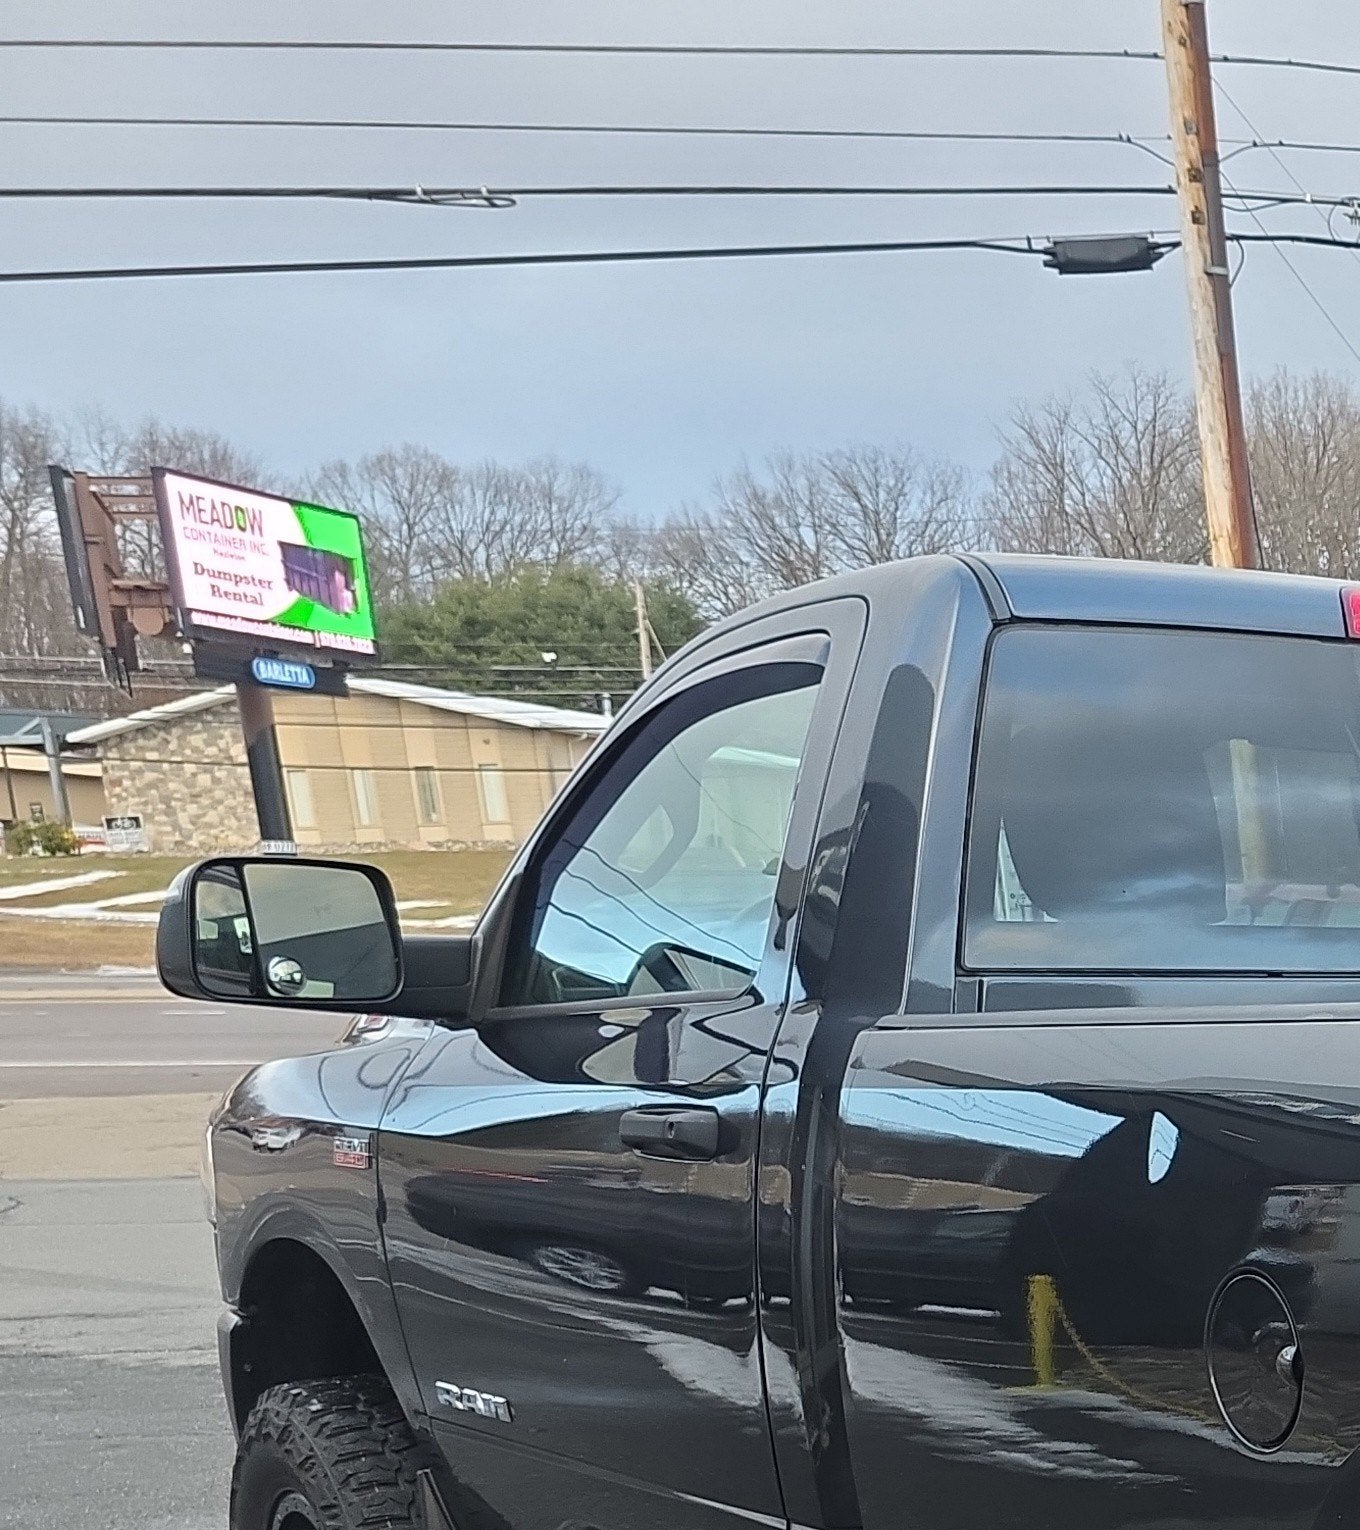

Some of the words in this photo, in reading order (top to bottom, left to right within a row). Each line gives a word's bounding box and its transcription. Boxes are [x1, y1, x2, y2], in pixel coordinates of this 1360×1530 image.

[178, 491, 264, 537] MEADOW
[193, 561, 274, 590] Dumpster
[210, 583, 264, 606] Rental
[435, 1380, 514, 1422] RAM
